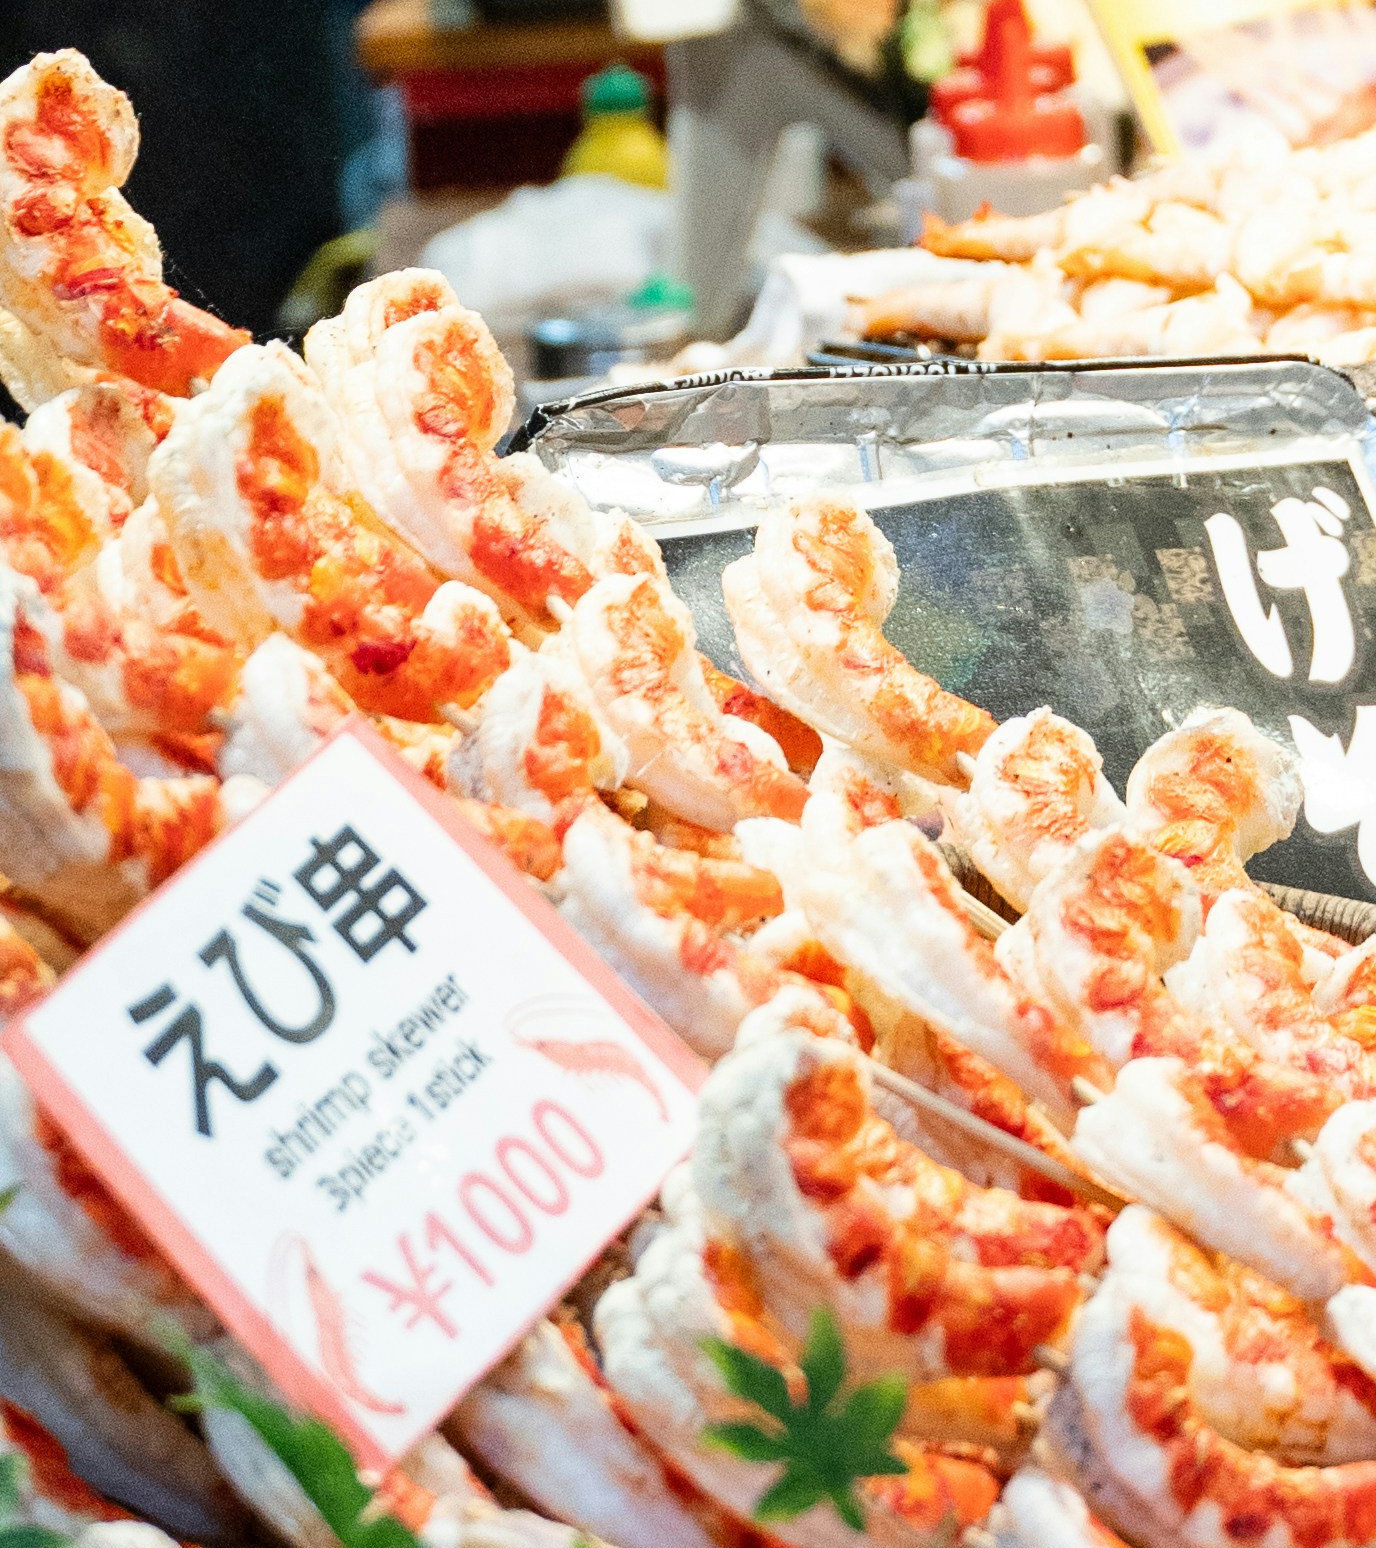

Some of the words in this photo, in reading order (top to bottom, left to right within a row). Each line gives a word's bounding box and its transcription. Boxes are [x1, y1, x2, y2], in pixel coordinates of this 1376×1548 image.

[126, 821, 428, 1140] えび串
[262, 1070, 373, 1181] shrimp
[365, 970, 471, 1081] skewer
[361, 1098, 607, 1341] ¥1000
